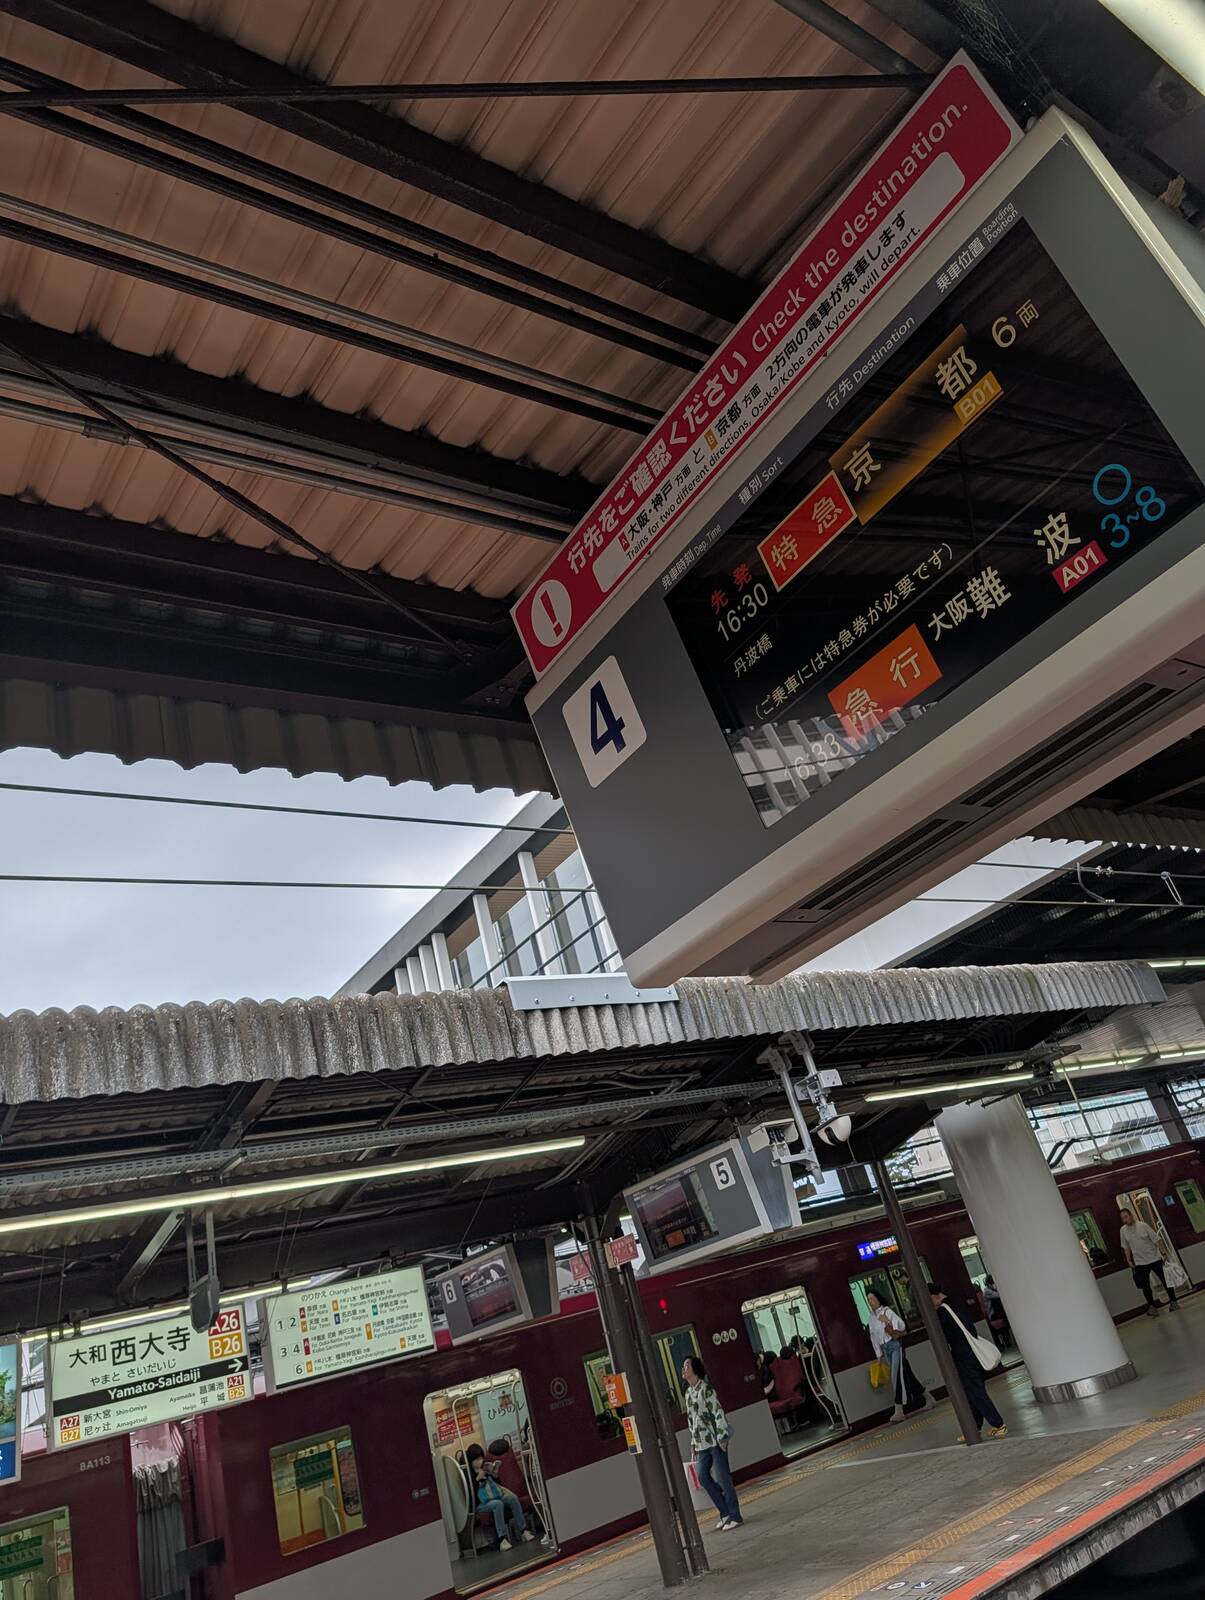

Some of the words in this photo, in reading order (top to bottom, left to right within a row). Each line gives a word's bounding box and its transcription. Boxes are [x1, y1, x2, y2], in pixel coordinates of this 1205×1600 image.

[982, 202, 1015, 236] Boarding
[986, 209, 1018, 243] Position
[936, 238, 985, 293] 乗車位置
[567, 351, 748, 575] 行先をご確認ください
[751, 286, 807, 352] Check
[804, 248, 840, 289] the
[841, 103, 968, 247] destination.
[627, 482, 674, 541] 大阪・神戸
[674, 464, 692, 488] 方面
[693, 446, 705, 464] と
[715, 405, 742, 437] 京都
[743, 384, 761, 409] 方面
[765, 210, 907, 381] 2方向の電車が発車します
[826, 379, 853, 410] 行先
[853, 316, 915, 383] Destination
[626, 533, 649, 561] Trains
[648, 519, 662, 537] for
[660, 504, 676, 523] two
[676, 466, 710, 505] different
[709, 419, 752, 467] directions,
[751, 354, 806, 418] Osaka/Kobe
[806, 333, 825, 357] and
[825, 298, 860, 335] Kyoto,
[859, 269, 880, 295] will
[881, 227, 921, 272] depart.
[957, 379, 996, 418] B01
[738, 475, 763, 505] 種別
[762, 456, 785, 481] Sort
[661, 547, 695, 590] 発車時刻
[694, 540, 709, 557] Dep.
[706, 524, 722, 542] Time
[716, 582, 769, 641] 16:30
[770, 496, 842, 572] 特急
[1062, 547, 1099, 588] A01
[734, 633, 774, 678] 丹波橋
[844, 647, 922, 724] 急行
[590, 680, 627, 756] 4
[716, 1162, 730, 1185] 5
[301, 1290, 327, 1302] のりかえ
[445, 1283, 454, 1301] 6
[209, 1311, 239, 1335] A26
[69, 1326, 190, 1369] 大和西大寺
[211, 1336, 242, 1359] B26
[89, 1372, 121, 1387] やまと
[127, 1358, 177, 1379] さいだいじ
[108, 1367, 201, 1400] Yamato-Saidaiji
[228, 1376, 244, 1388] A21
[229, 1388, 245, 1400] B25
[61, 1416, 79, 1429] A27
[83, 1408, 112, 1424] 新大宮
[115, 1403, 148, 1417] Shin-Omiya
[61, 1430, 80, 1443] B27
[116, 1416, 148, 1429] Amagatsuji
[80, 1456, 111, 1471] 8A113
